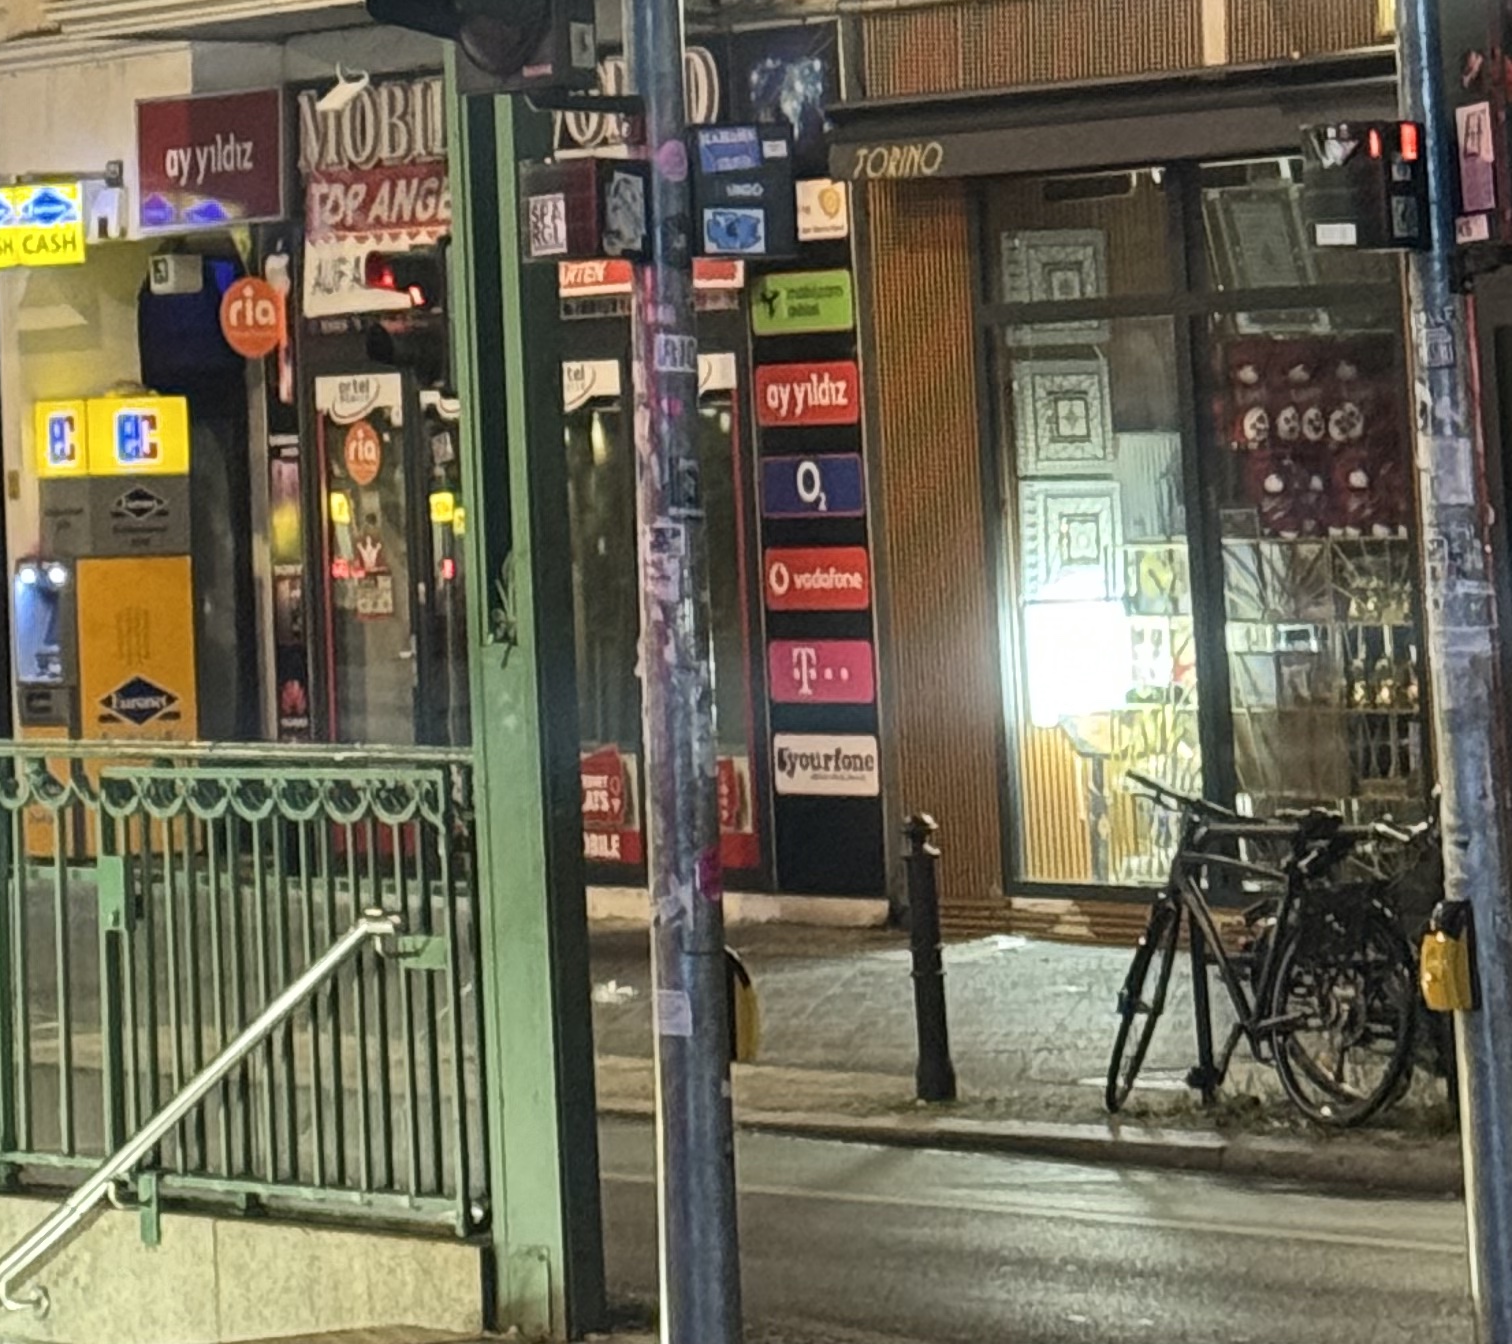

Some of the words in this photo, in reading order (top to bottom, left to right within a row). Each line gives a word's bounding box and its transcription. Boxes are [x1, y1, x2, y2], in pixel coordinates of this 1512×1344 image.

[165, 146, 192, 187] ay
[853, 141, 944, 179] TORINO
[22, 232, 77, 255] CASH
[229, 286, 275, 327] ria
[766, 383, 791, 417] ay
[350, 429, 378, 460] ria
[794, 567, 863, 590] vodafone
[786, 747, 874, 778] yourfone
